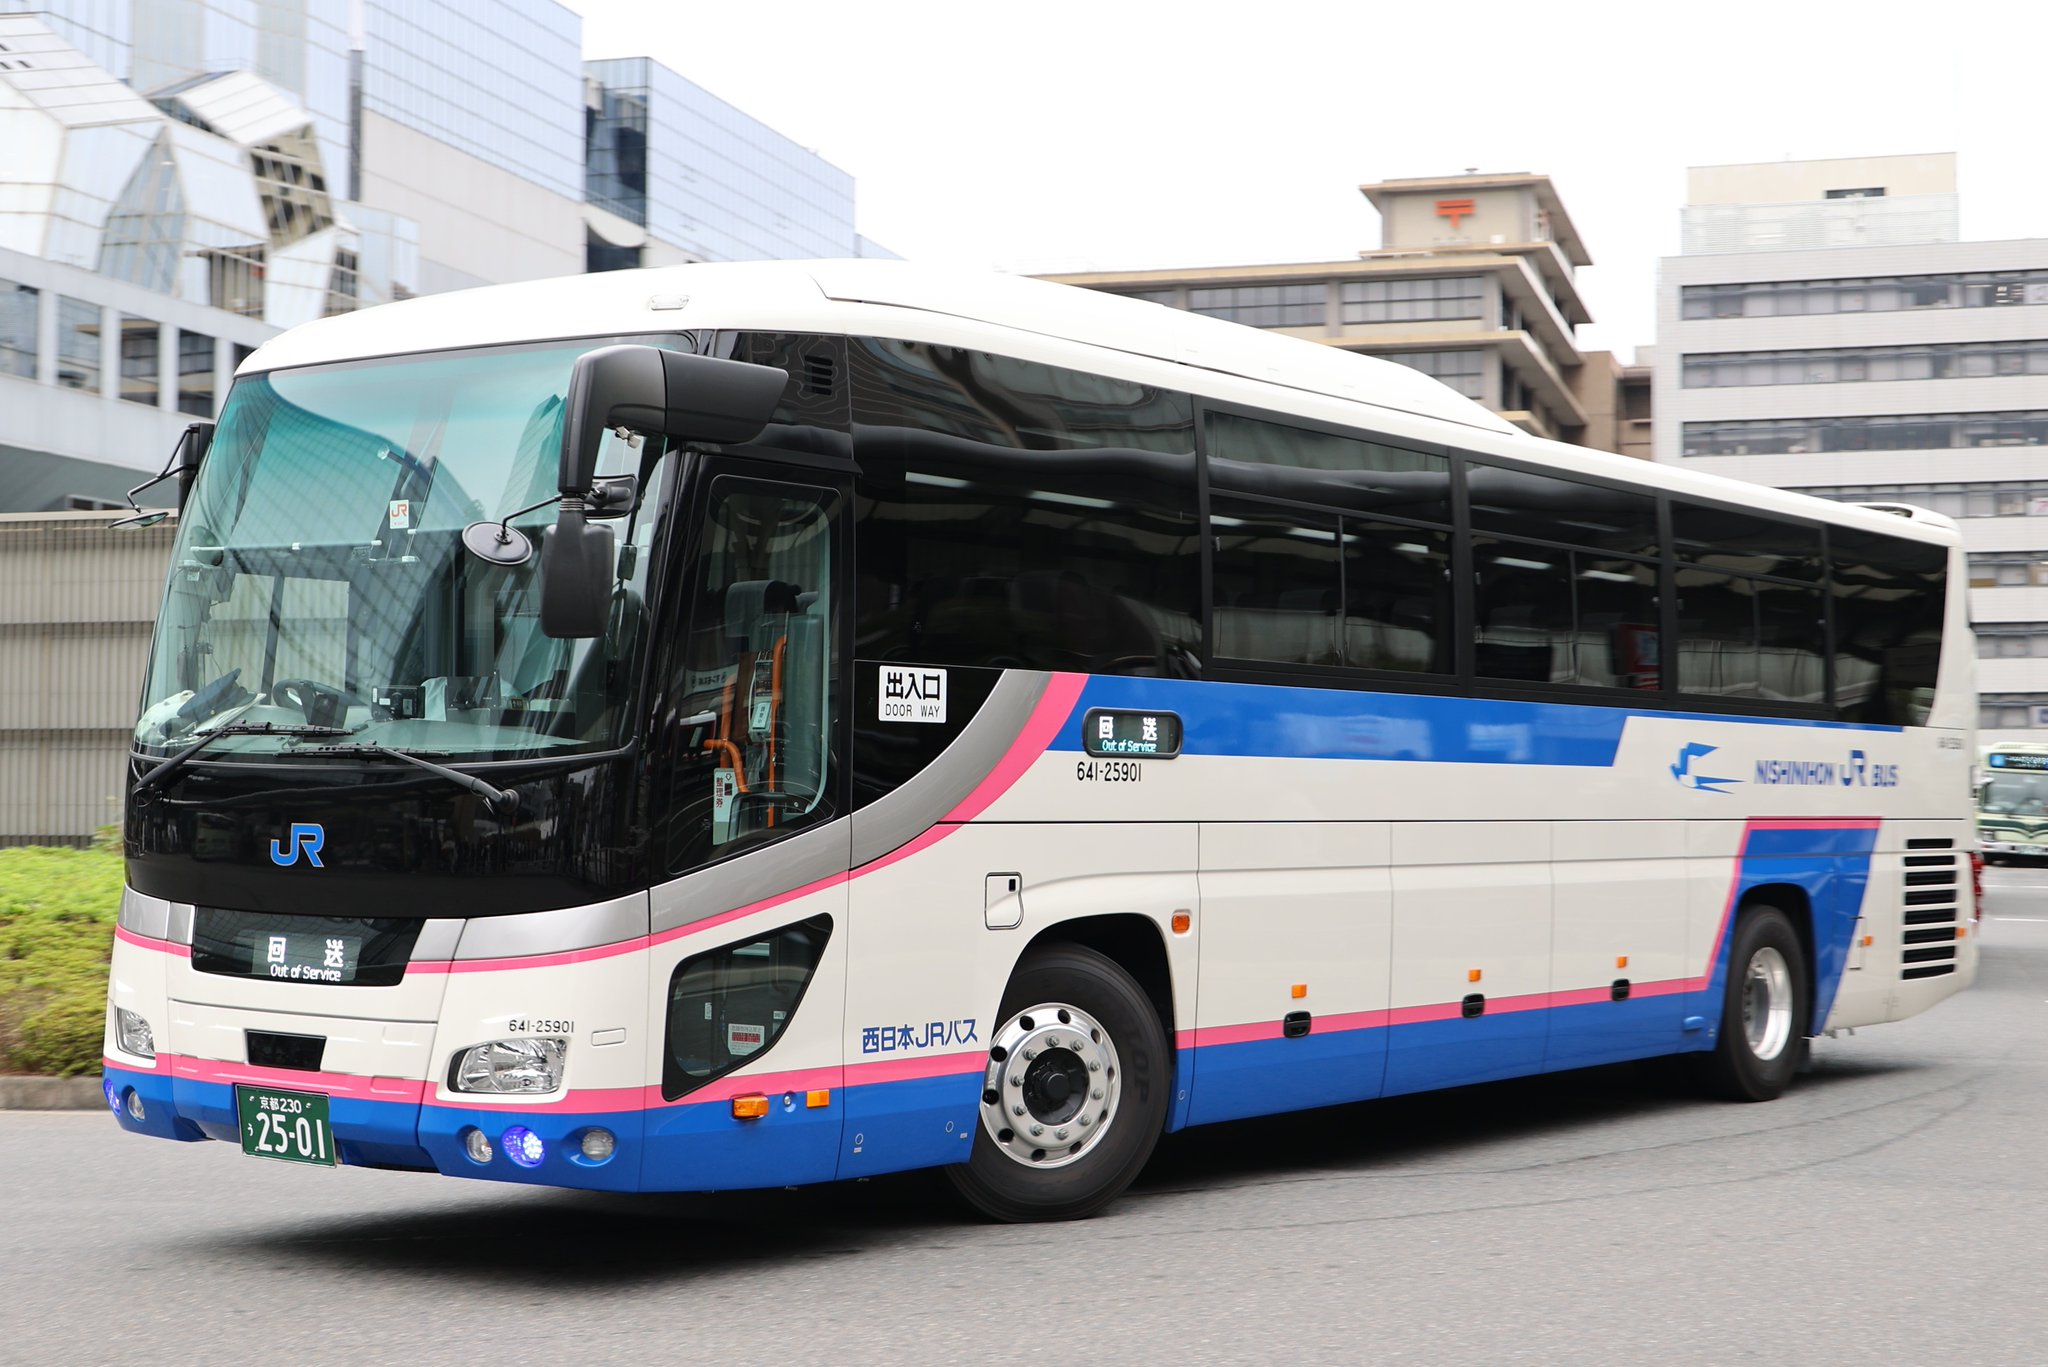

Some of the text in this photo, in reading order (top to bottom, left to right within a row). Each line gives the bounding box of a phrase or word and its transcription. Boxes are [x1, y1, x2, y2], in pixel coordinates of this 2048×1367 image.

[391, 503, 407, 517] JR
[886, 672, 940, 701] 出入口
[885, 703, 940, 718] DOOR WAY
[1102, 739, 1157, 752] Out of Service
[1077, 761, 1141, 782] 641-25901
[1754, 750, 1898, 787] NISHINIHON JR BUS
[271, 822, 325, 867] JR
[270, 964, 342, 981] Out of Service
[509, 1019, 574, 1033] 641-25901
[862, 1019, 978, 1054] 西日本JRバス
[256, 1112, 325, 1159] 25-01
